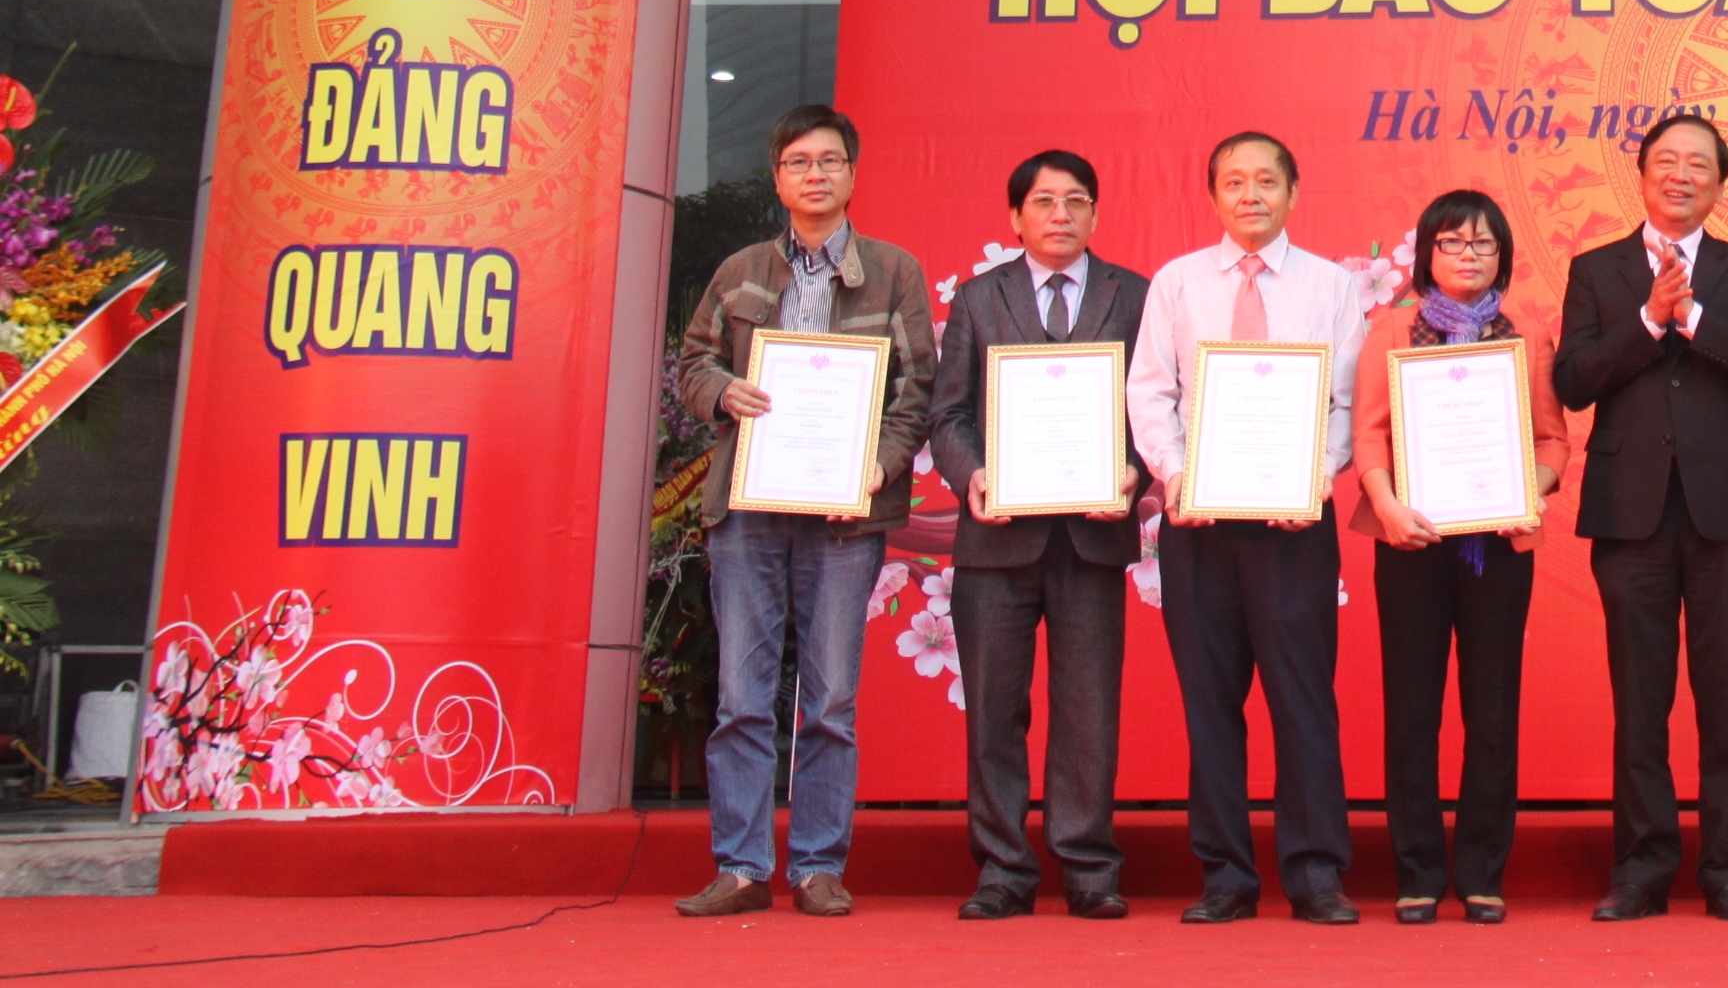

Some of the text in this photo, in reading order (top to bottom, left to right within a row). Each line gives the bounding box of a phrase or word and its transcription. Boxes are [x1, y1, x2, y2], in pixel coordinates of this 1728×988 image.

[300, 28, 515, 175] ĐẢNG
[1358, 89, 1442, 142] Hà
[1455, 88, 1567, 154] Nội,
[264, 244, 519, 370] QUANG
[278, 433, 468, 548] VINH
